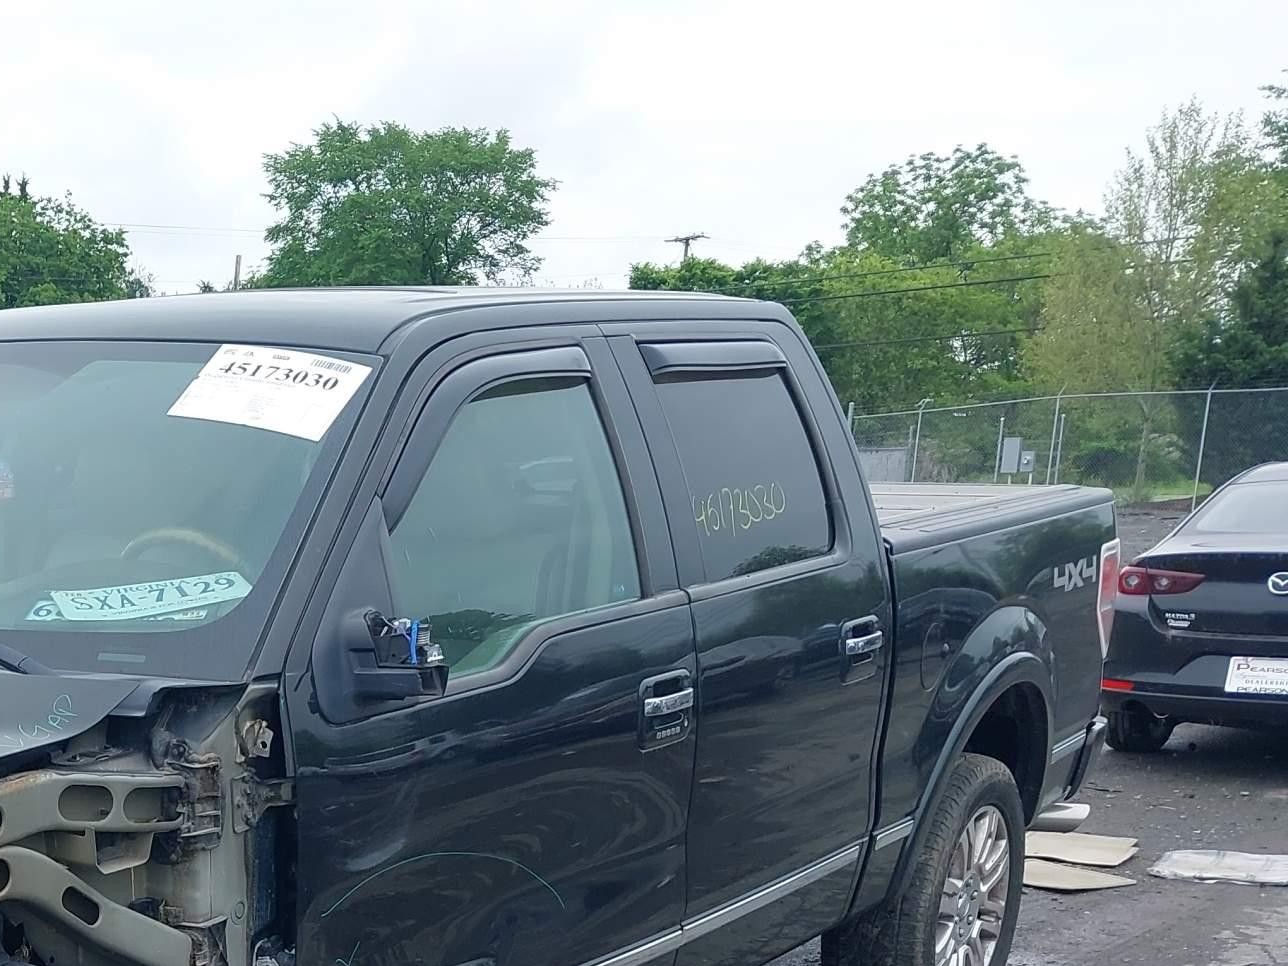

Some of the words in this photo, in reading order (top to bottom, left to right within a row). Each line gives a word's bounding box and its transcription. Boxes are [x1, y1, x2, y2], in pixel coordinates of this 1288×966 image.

[219, 361, 339, 391] 45173030
[100, 580, 191, 596] VIRGINIA
[1053, 555, 1097, 591] 4X4
[70, 577, 236, 610] SXA-7129
